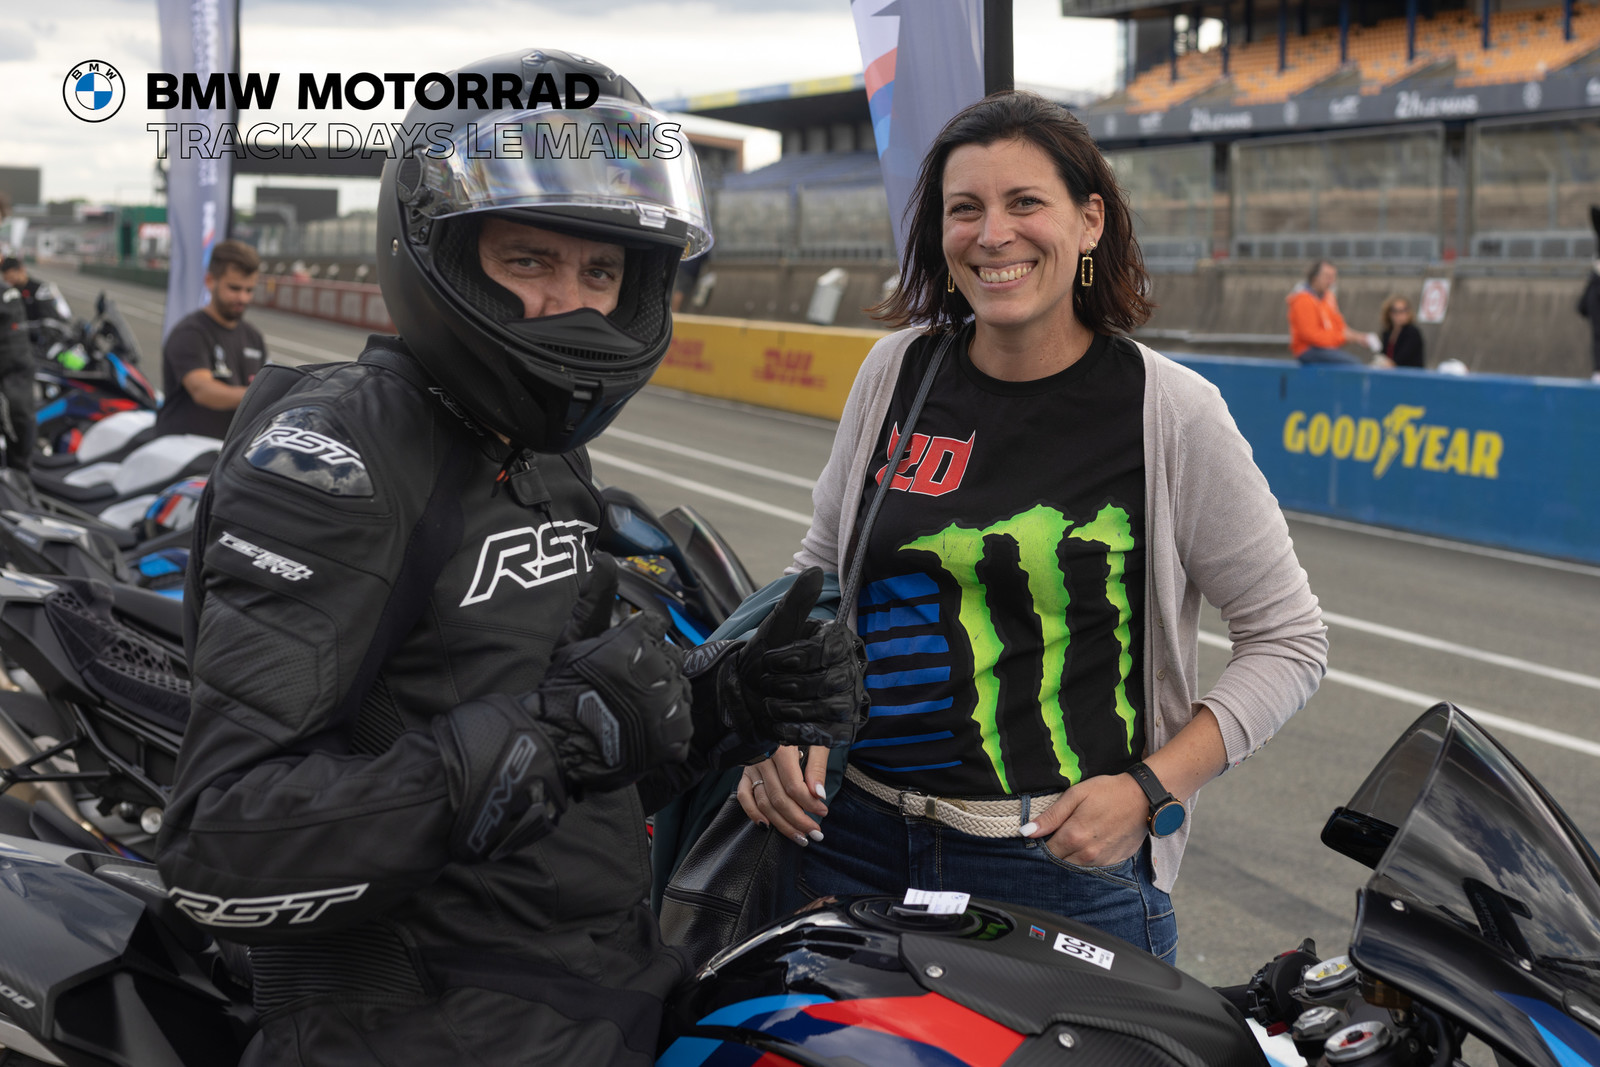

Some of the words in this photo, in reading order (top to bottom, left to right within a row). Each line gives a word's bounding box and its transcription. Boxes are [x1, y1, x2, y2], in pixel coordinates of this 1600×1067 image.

[250, 426, 366, 471] RST
[875, 421, 976, 497] 20
[1283, 404, 1504, 479] GOODYEAR
[459, 519, 599, 608] RST
[168, 883, 370, 928] RST
[1061, 937, 1096, 960] 56
